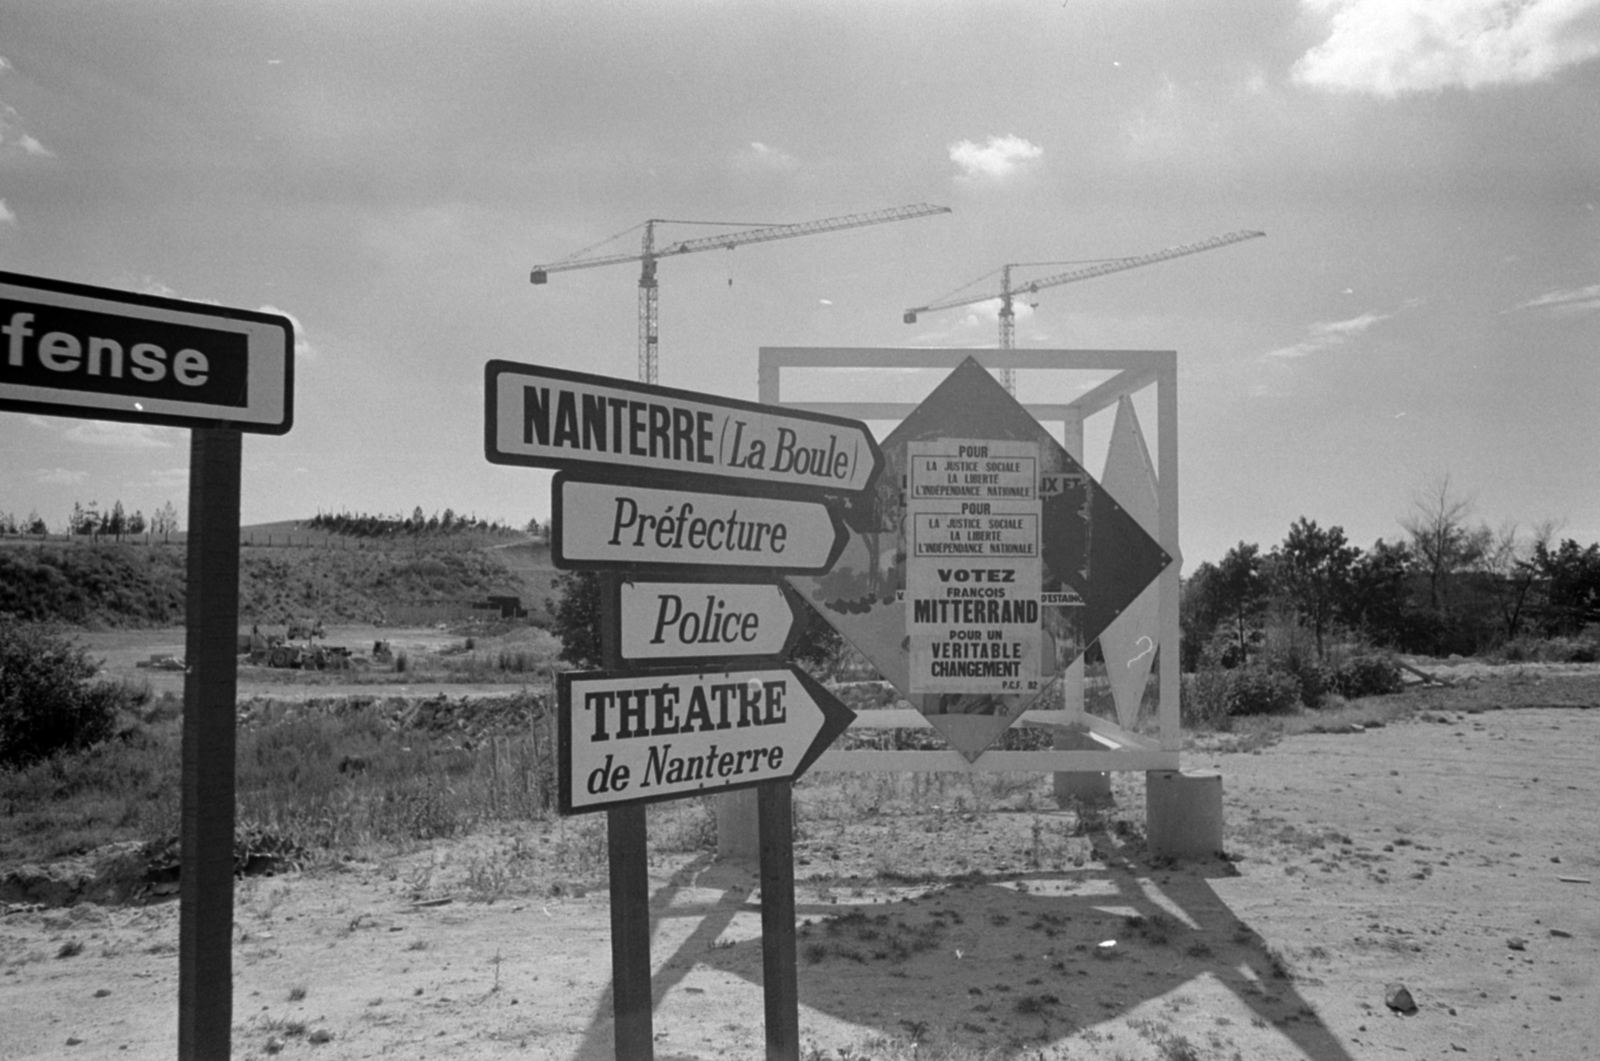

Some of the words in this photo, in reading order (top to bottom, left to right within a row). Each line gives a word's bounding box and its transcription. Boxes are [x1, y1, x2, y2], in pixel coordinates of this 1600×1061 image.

[1, 312, 209, 386] fense
[523, 385, 714, 464] NANTERRE
[718, 414, 766, 470] (La
[770, 427, 858, 482] Boule)
[959, 445, 988, 458] POUR
[926, 461, 937, 471] LA
[944, 461, 978, 472] JUSTICE
[986, 462, 1021, 473] SOCIALE
[948, 473, 958, 484] LA
[987, 486, 1030, 497] NATIONALE
[962, 503, 991, 515] POUR
[608, 497, 788, 553] Préfecture
[929, 519, 939, 529] LA
[947, 519, 981, 529] JUSTICE
[989, 519, 1024, 529] SOCIALE
[950, 531, 960, 541] LA
[990, 543, 1033, 554] NATIONALE
[938, 569, 1015, 583] VOTEZ
[914, 599, 1038, 624] MITTERRAND
[650, 594, 759, 645] Police
[950, 630, 982, 640] POUR
[987, 630, 1002, 640] UN
[932, 642, 1021, 658] VERITABLE
[931, 661, 1021, 677] CHANGEMENT
[585, 680, 787, 742] THÉATRE
[587, 754, 630, 795] de
[640, 744, 784, 788] Nanterre
